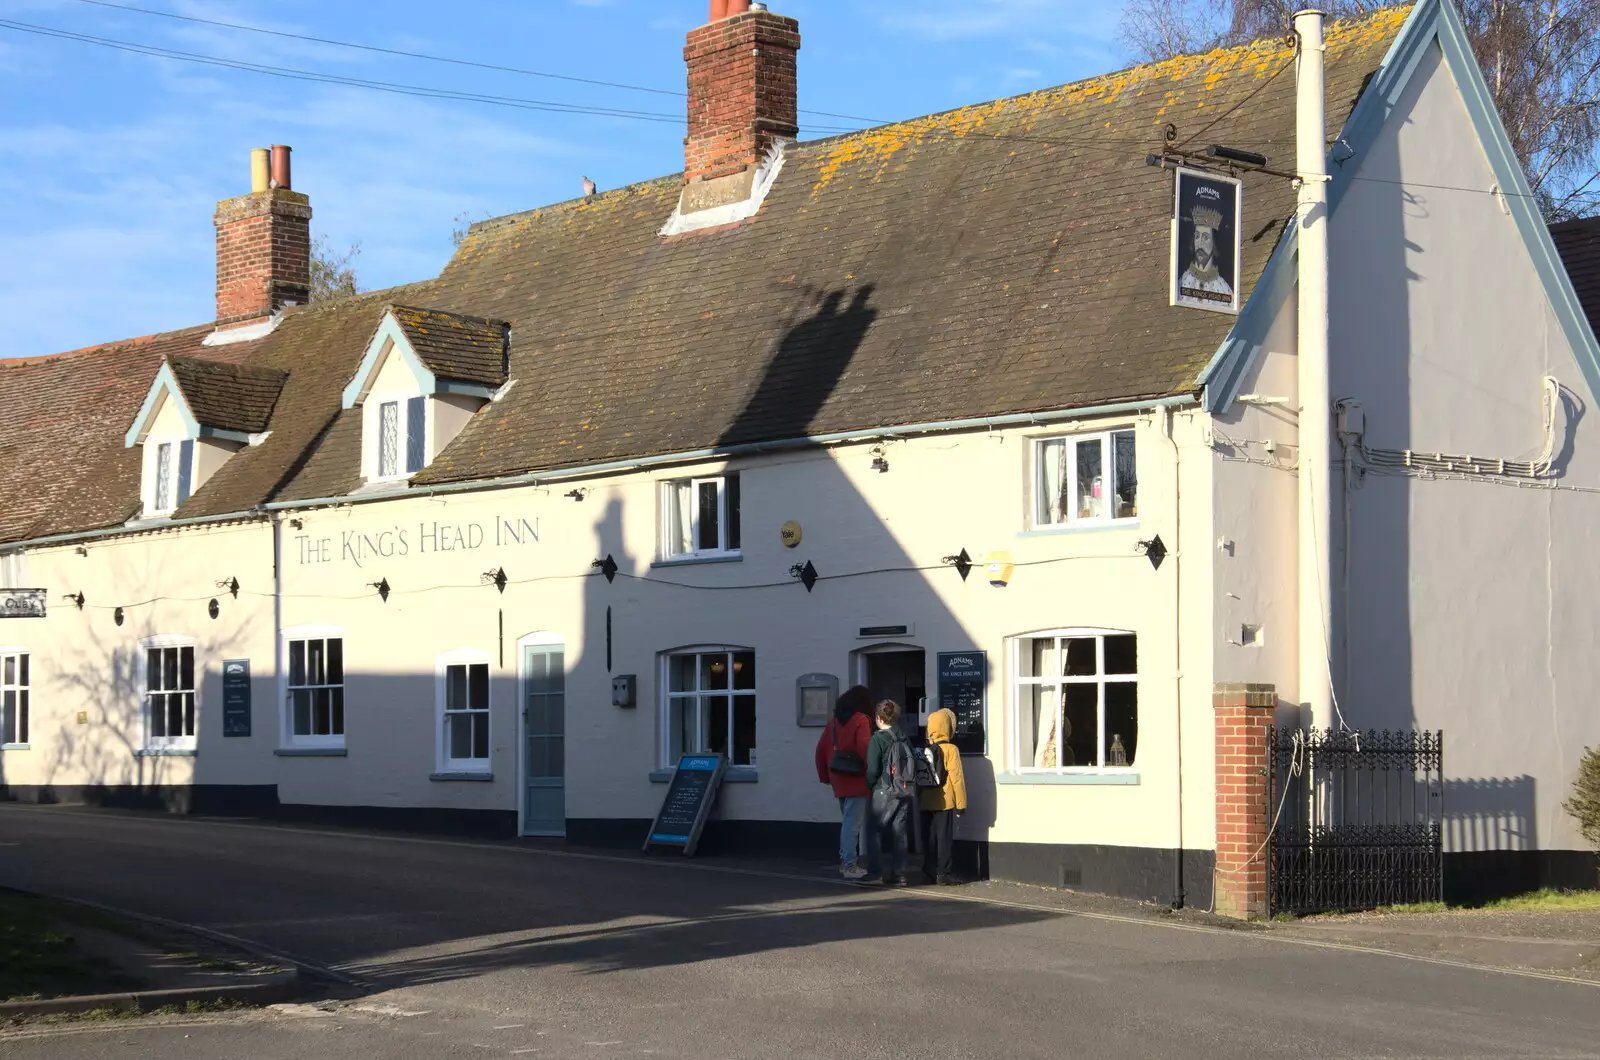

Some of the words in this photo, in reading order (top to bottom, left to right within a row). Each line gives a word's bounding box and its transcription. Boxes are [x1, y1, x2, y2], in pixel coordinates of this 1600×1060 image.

[1195, 186, 1220, 199] ADNAMS
[294, 535, 331, 564] THE
[342, 525, 409, 568] KING'S
[420, 522, 483, 552] HEAD
[496, 515, 539, 546] INN
[5, 597, 36, 611] Quay
[949, 657, 973, 667] ADNAMS
